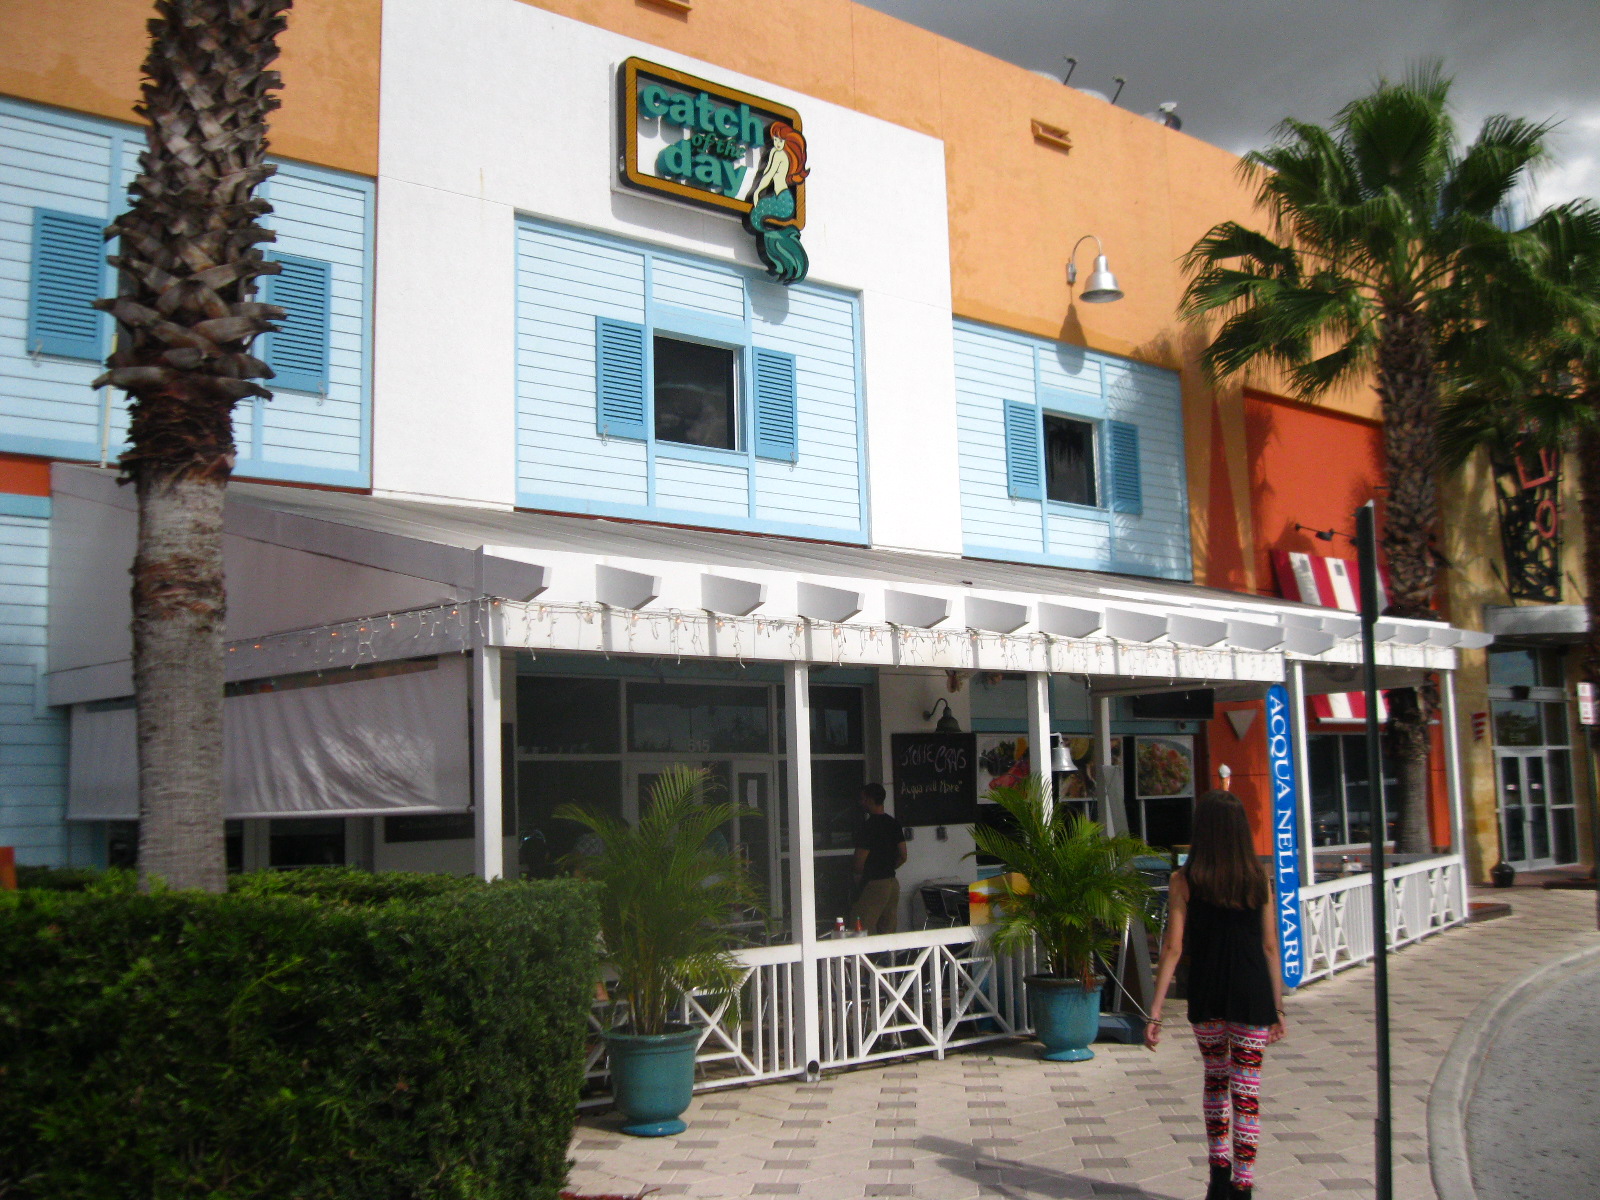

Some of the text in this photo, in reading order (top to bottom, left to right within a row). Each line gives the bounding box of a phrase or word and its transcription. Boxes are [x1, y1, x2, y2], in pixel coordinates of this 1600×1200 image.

[640, 85, 764, 146] catch
[658, 140, 748, 199] day
[691, 133, 746, 160] of the
[1269, 695, 1301, 978] ACQUA NELL MARE
